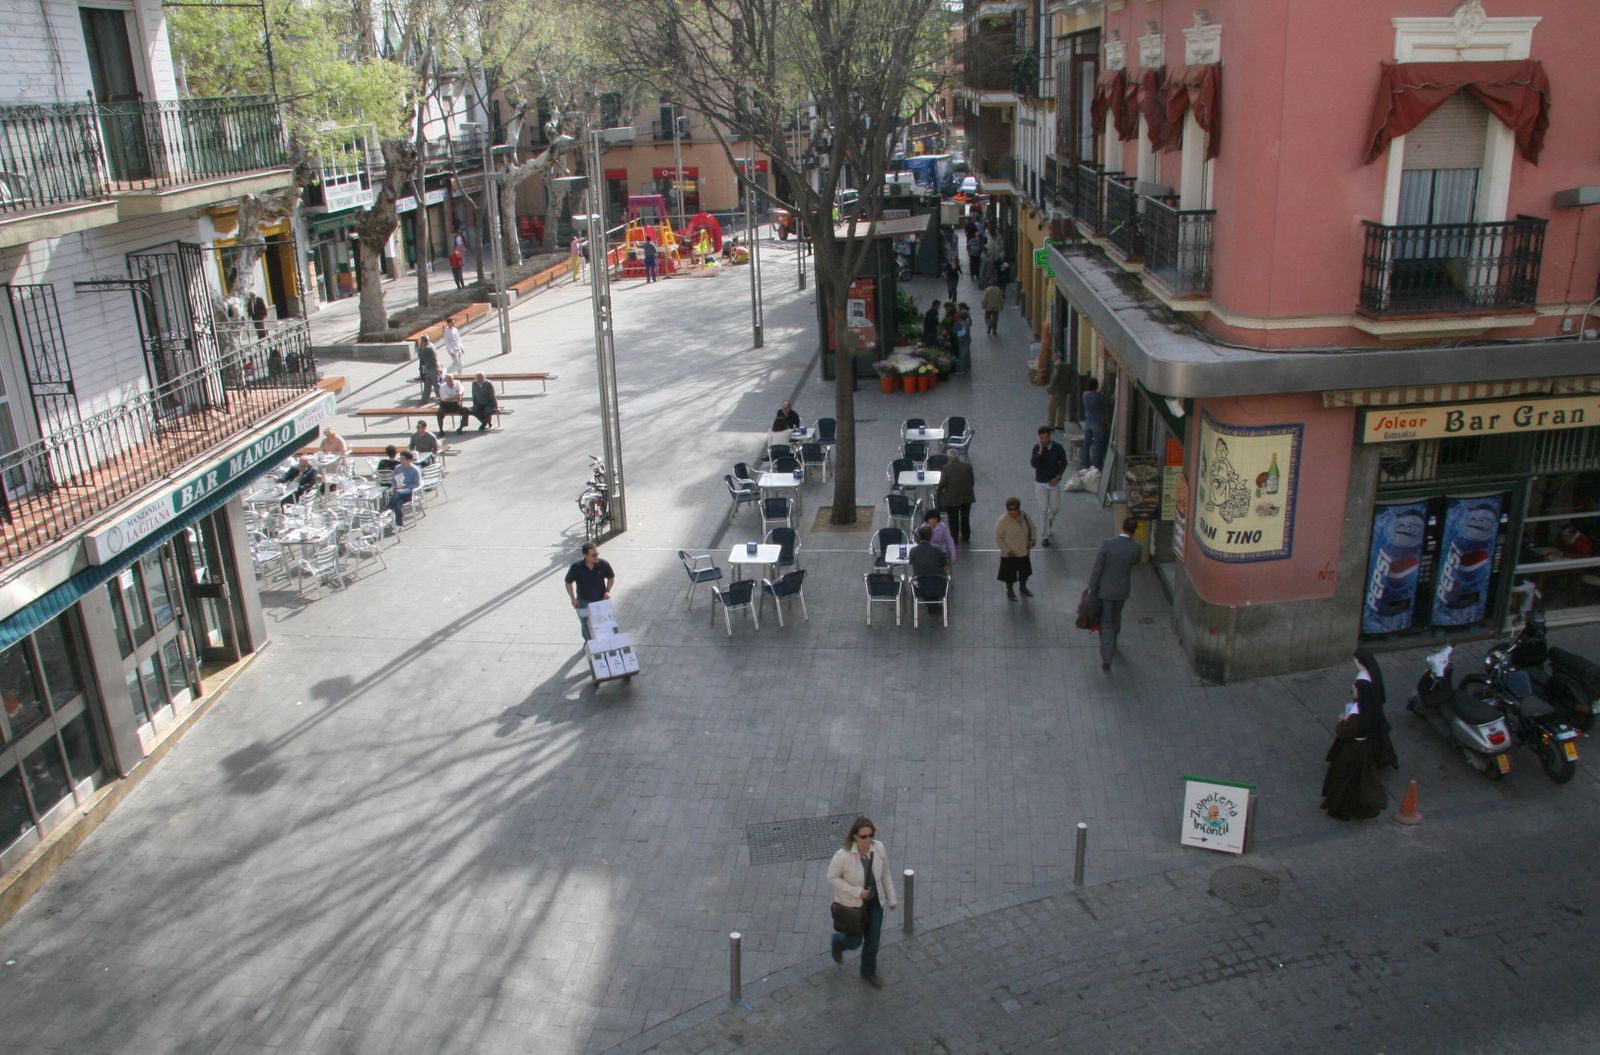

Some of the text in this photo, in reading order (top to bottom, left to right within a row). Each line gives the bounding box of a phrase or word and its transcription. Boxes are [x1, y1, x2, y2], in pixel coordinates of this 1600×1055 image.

[1373, 415, 1427, 431] Solear
[1444, 405, 1585, 432] Bar Gran
[181, 424, 291, 508] BAR MANOLO
[127, 500, 166, 526] MANZANILLA
[127, 508, 171, 543] LA GITANA
[1225, 530, 1263, 545] TINO
[1367, 548, 1393, 612] PEPSI
[1437, 541, 1463, 605] PEPSI
[1194, 818, 1229, 836] Infantil
